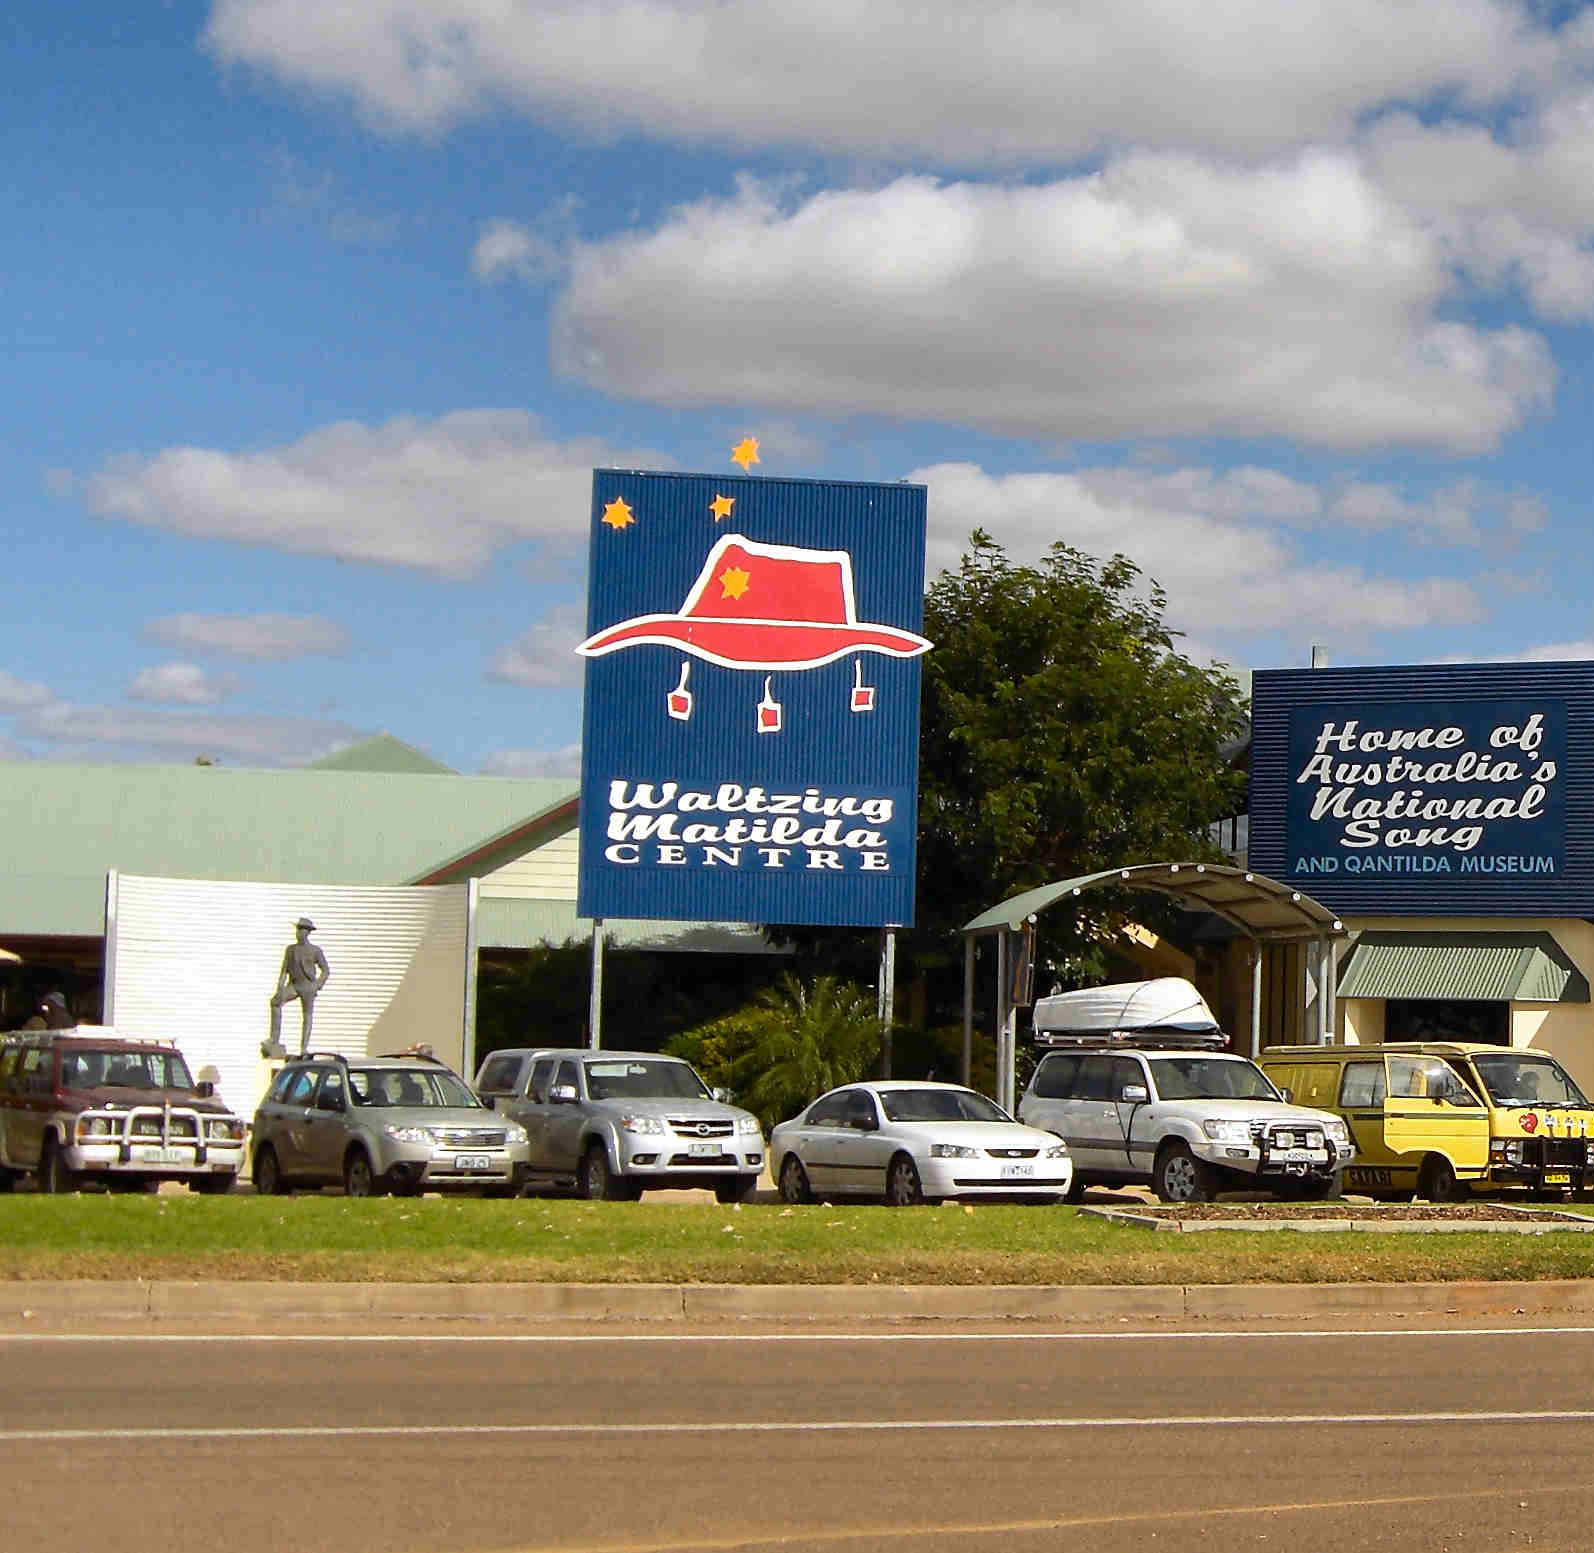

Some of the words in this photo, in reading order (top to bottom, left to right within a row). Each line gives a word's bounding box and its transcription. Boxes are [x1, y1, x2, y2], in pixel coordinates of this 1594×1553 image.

[1315, 720, 1465, 753] Home
[1489, 713, 1545, 751] of
[1297, 751, 1557, 786] Australia's
[608, 779, 894, 824] Waltzing
[1309, 784, 1546, 821] National
[607, 812, 888, 847] Matilda
[1340, 820, 1484, 850] Song
[604, 844, 890, 871] CENTRE
[1295, 857, 1339, 873] AND
[1344, 855, 1450, 874] QANTILDA
[1460, 855, 1554, 873] MUSEUM
